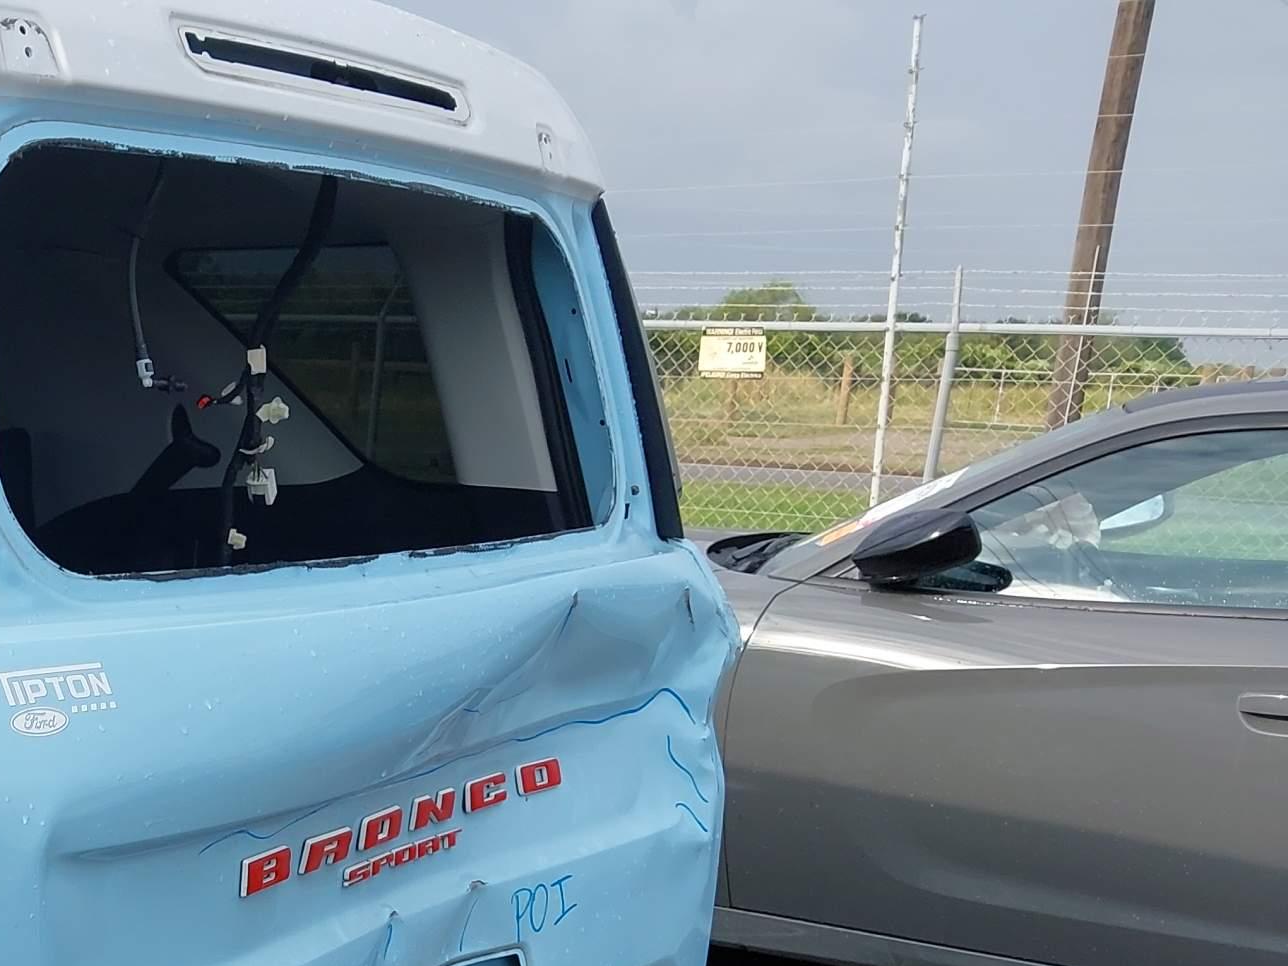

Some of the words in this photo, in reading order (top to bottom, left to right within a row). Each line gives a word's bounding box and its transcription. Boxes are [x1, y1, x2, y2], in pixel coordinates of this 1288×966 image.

[727, 342, 755, 355] 7,000
[758, 342, 763, 353] V
[239, 757, 562, 897] BRONCO
[342, 828, 462, 888] SPORT
[511, 874, 578, 944] POI
